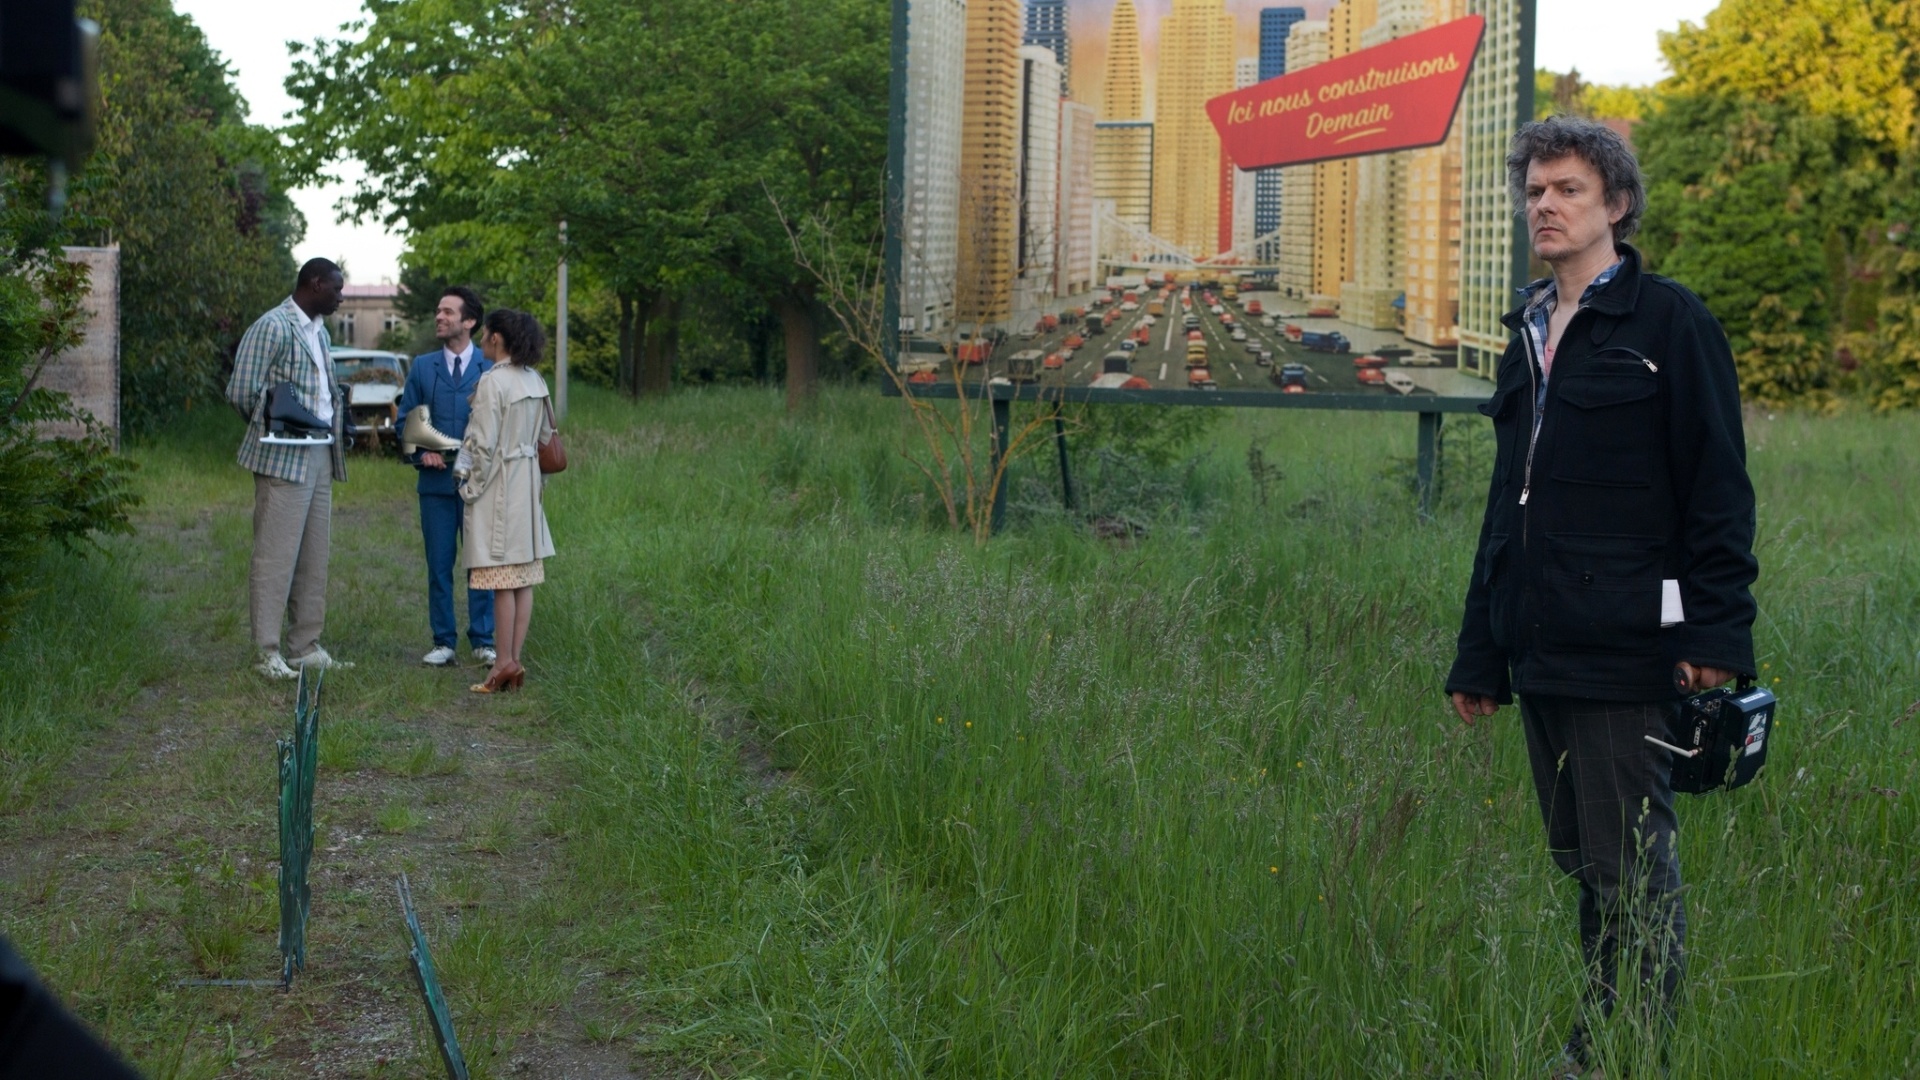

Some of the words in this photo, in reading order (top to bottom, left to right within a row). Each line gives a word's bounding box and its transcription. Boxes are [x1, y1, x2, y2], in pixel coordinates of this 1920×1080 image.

[1227, 100, 1255, 124] Ici
[1259, 90, 1313, 117] nous
[1318, 52, 1459, 102] construisons
[1306, 103, 1393, 138] Demain
